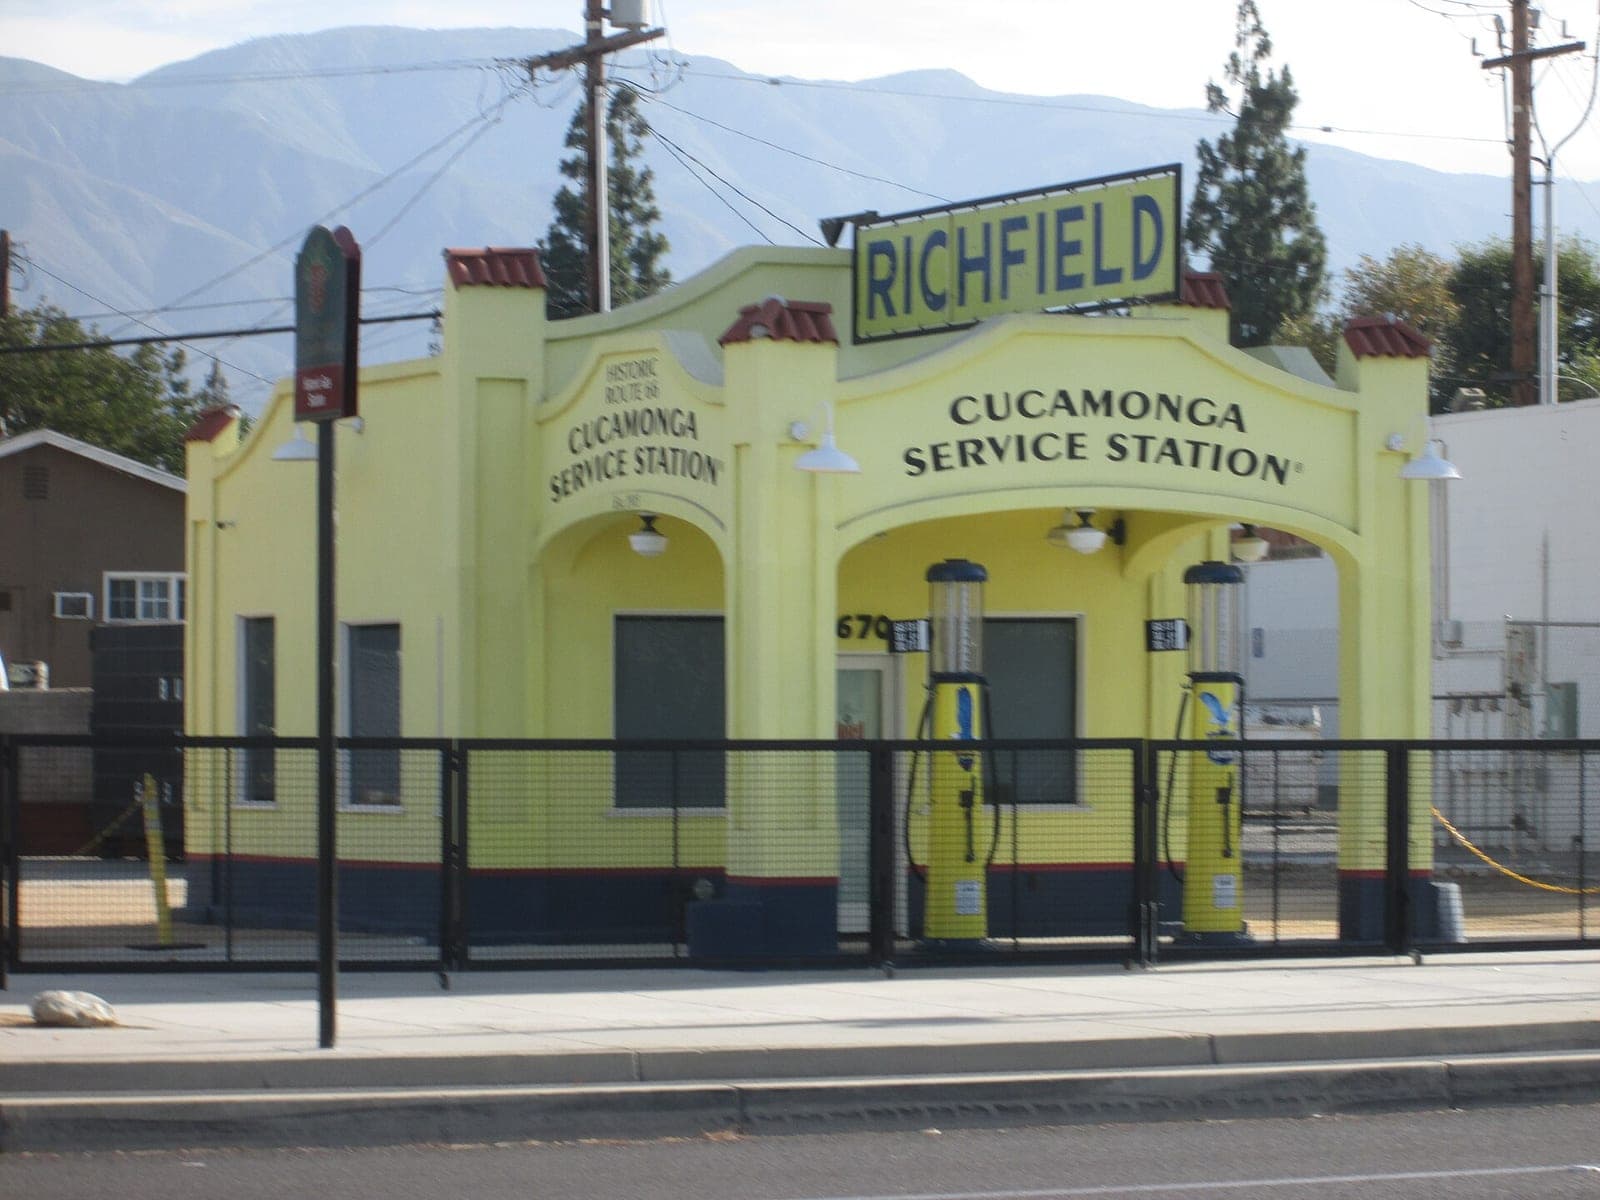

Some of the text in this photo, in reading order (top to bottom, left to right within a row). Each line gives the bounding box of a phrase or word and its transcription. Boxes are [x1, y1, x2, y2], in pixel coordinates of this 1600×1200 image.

[867, 194, 1164, 321] RICHFIELD
[568, 408, 698, 454] CUCAMONGA
[949, 389, 1247, 433] CUCAMONGA
[550, 446, 718, 503] SERVICE STATION
[903, 432, 1291, 486] SERVICE STATION
